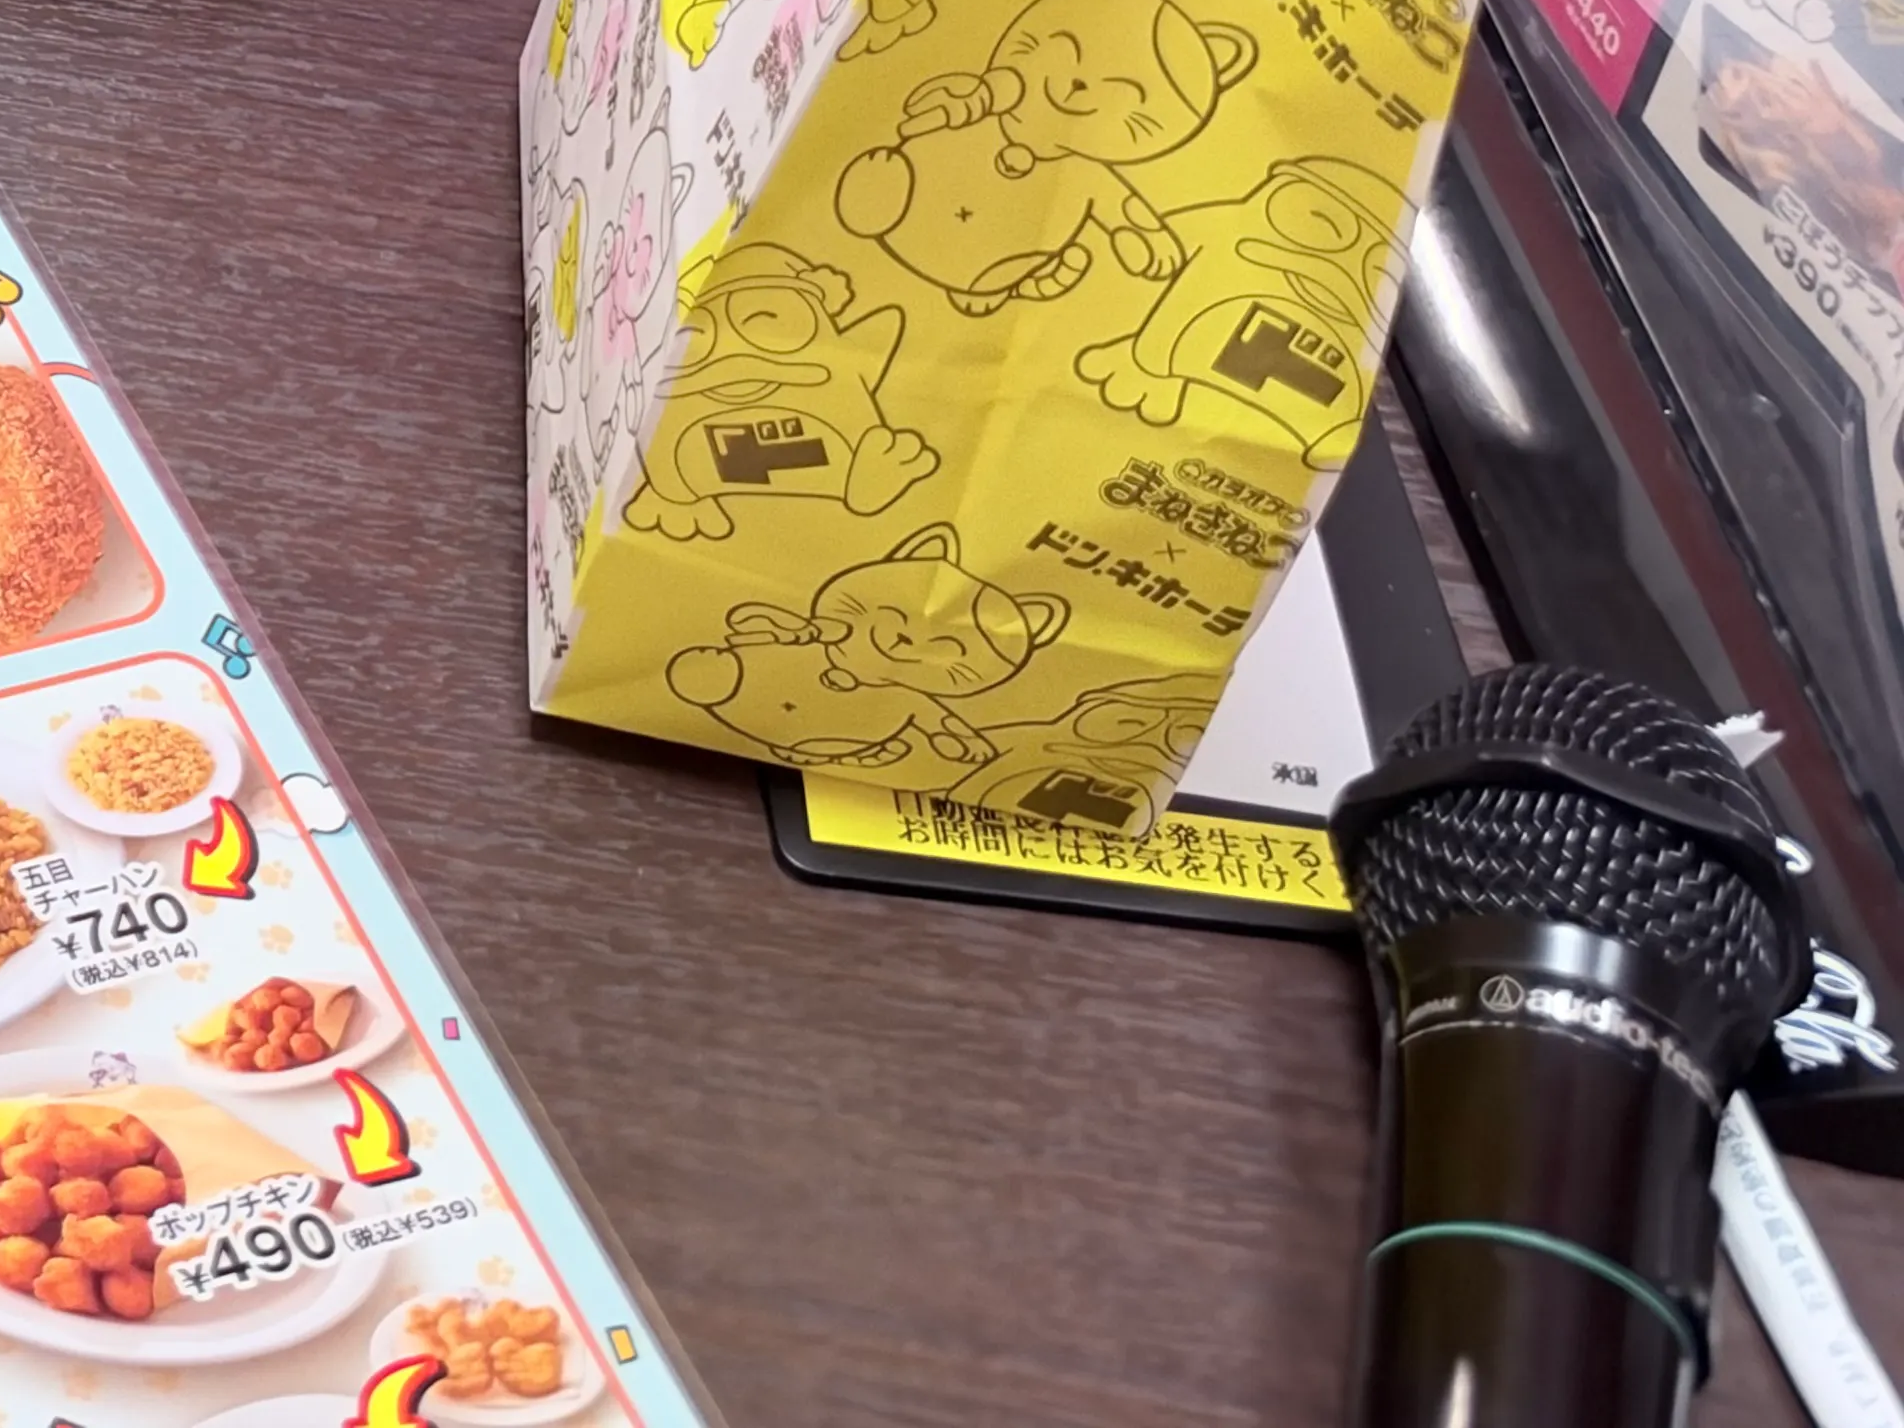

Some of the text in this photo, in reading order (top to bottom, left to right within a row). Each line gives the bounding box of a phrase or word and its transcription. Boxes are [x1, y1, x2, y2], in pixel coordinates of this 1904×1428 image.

[17, 857, 74, 890] 五目
[31, 862, 159, 913] チャーハン
[53, 889, 190, 961] ¥740
[71, 938, 199, 987] (税込¥814)
[155, 1176, 320, 1241] ポップチキン
[181, 1196, 478, 1295] ¥490 (税込¥539)
